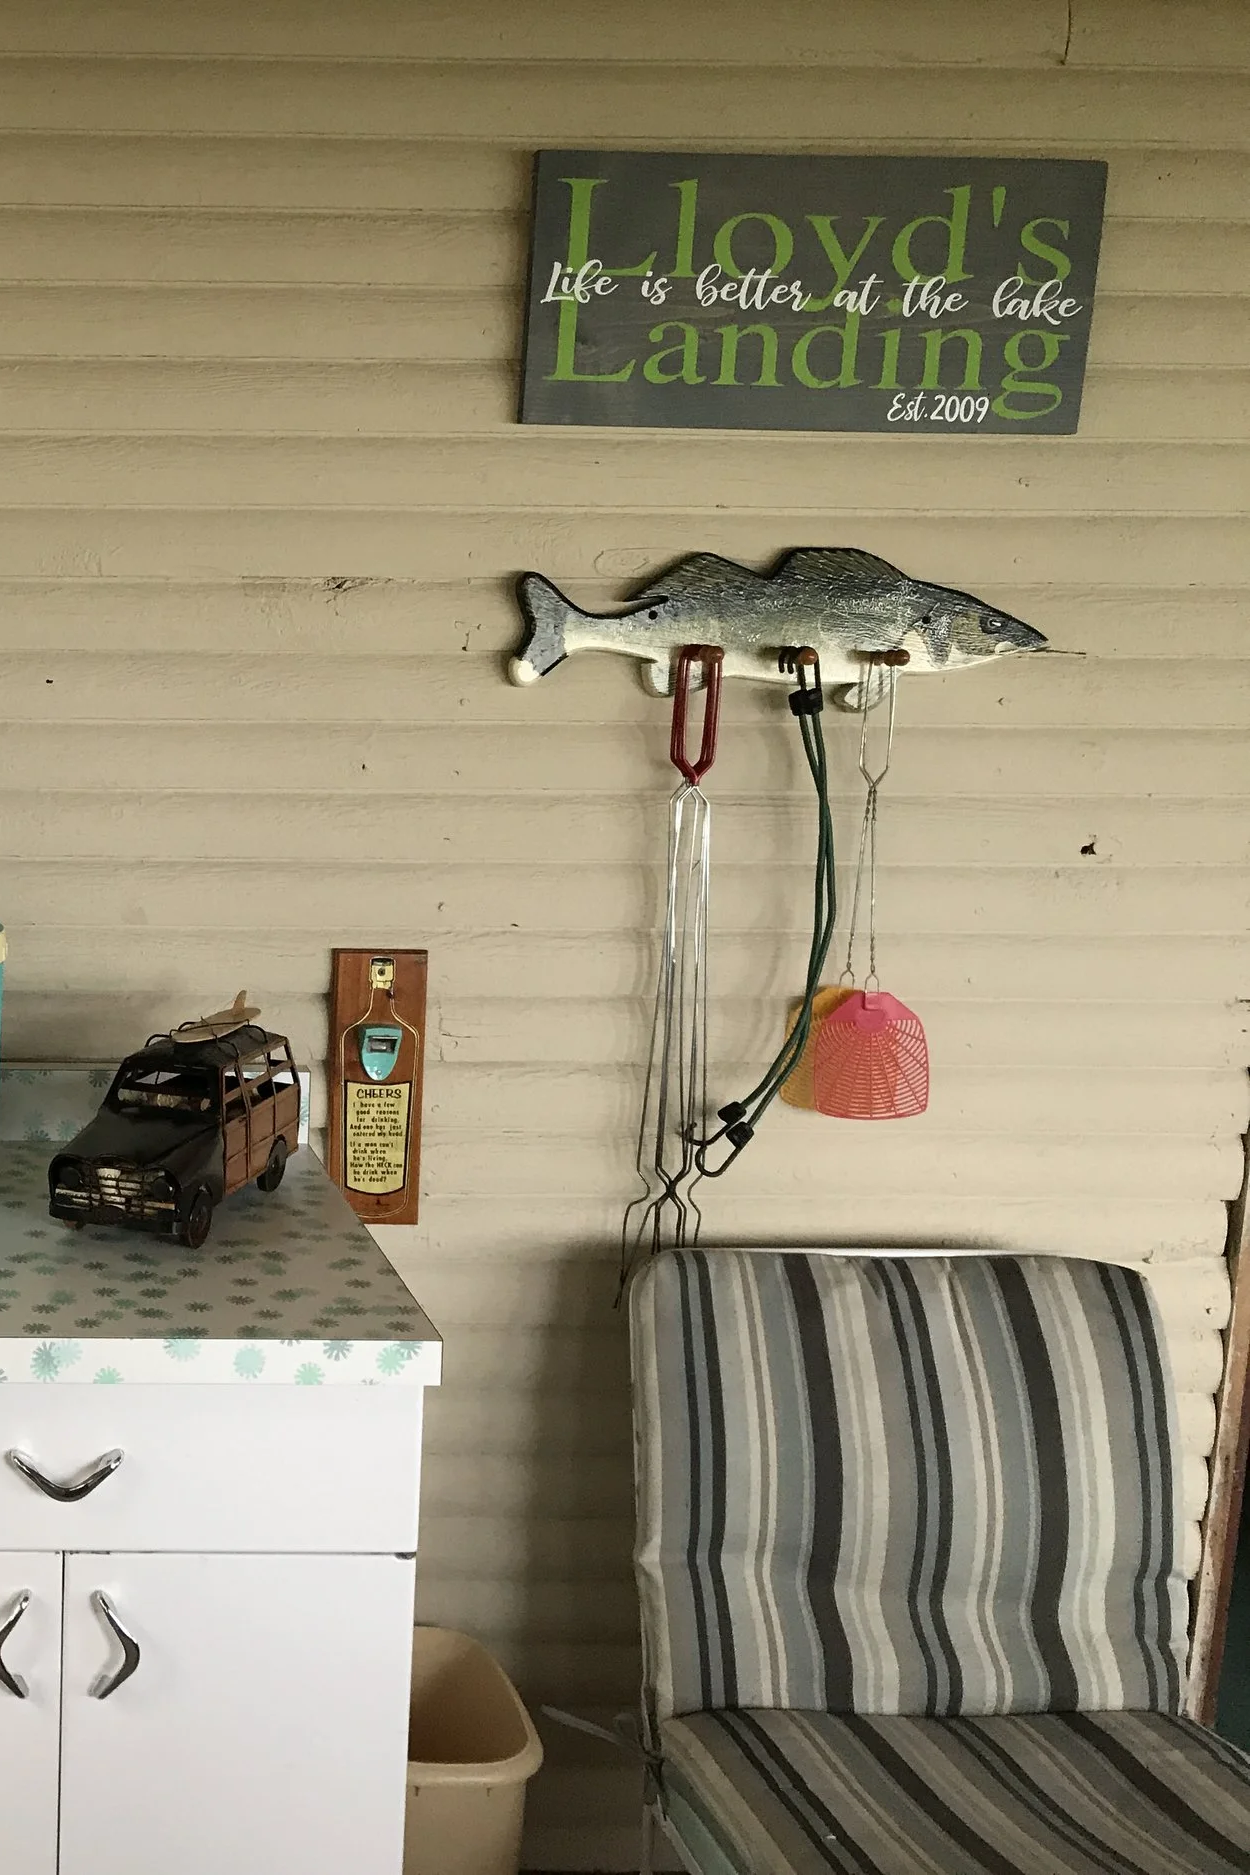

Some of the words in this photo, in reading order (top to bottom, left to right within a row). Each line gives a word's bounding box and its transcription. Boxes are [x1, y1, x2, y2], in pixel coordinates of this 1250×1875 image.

[557, 177, 1072, 312] Lloyd's
[540, 259, 619, 304] Life
[641, 271, 673, 306] is
[696, 263, 812, 312] better
[833, 273, 884, 316] at
[901, 275, 969, 319] the
[992, 275, 1083, 326] lake
[542, 295, 1070, 420] Landing
[356, 1088, 402, 1099] CHEERS
[356, 1108, 370, 1116] good
